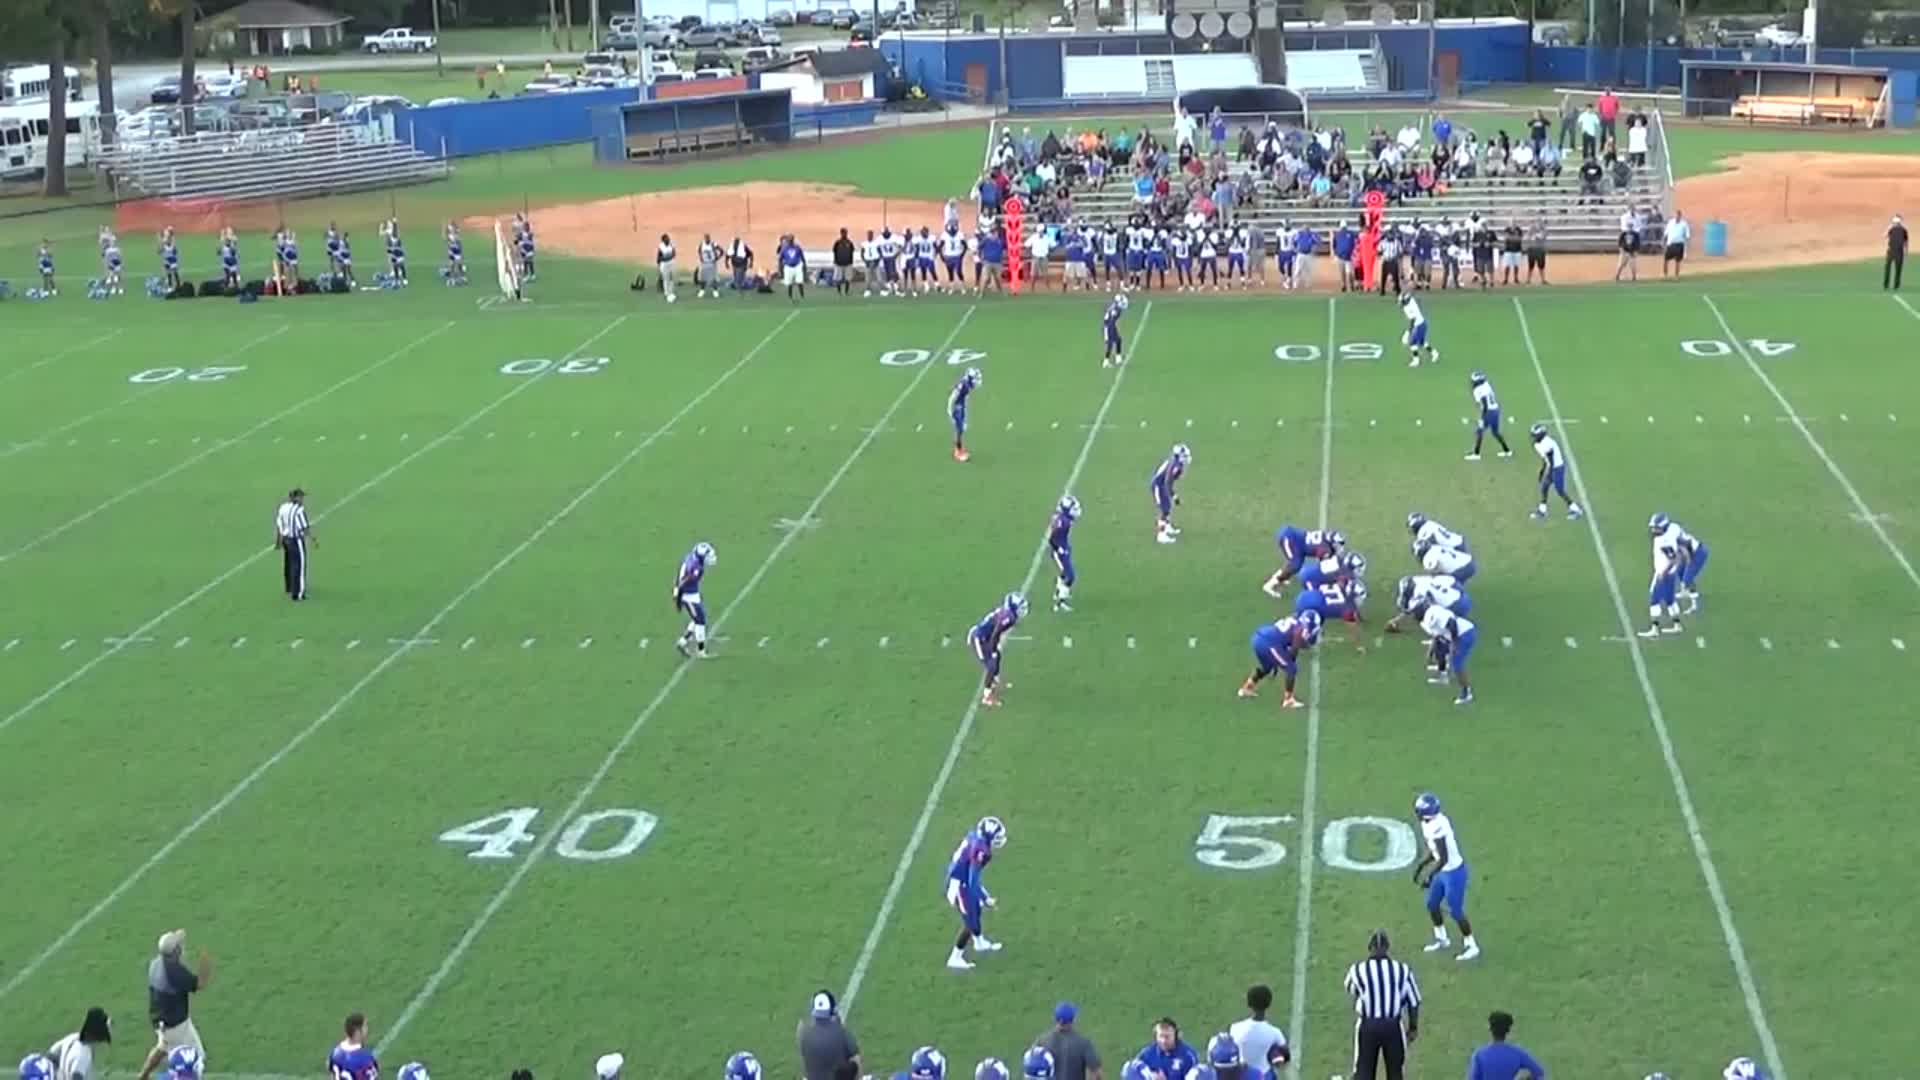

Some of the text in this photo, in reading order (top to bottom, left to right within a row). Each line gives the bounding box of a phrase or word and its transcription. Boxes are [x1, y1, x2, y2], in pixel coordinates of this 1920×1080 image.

[1275, 343, 1382, 360] 50
[1680, 339, 1796, 356] 40
[500, 357, 609, 374] 30
[879, 348, 987, 366] 40
[129, 366, 248, 382] 20
[439, 807, 658, 860] 40
[1195, 814, 1417, 870] 50
